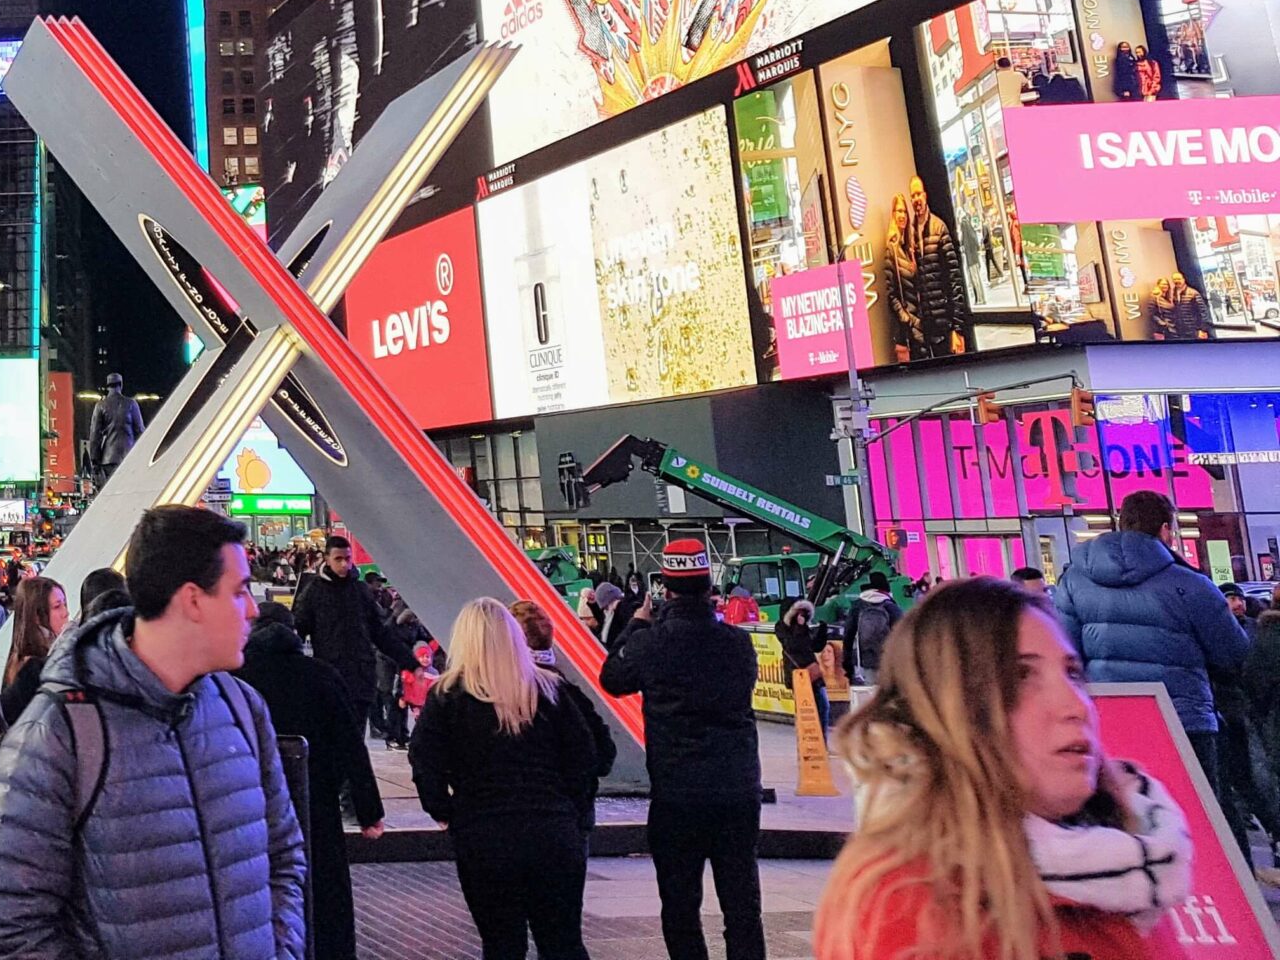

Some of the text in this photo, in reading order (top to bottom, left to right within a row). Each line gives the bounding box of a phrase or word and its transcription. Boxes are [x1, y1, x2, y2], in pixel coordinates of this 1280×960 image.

[500, 0, 544, 40] adidas
[756, 40, 804, 69] MARRIOTT
[757, 56, 801, 83] MARQUIS
[1095, 53, 1110, 79] WE
[1081, 131, 1093, 169] I
[1099, 129, 1207, 168] SAVE
[488, 164, 516, 182] MARRIOTT
[489, 176, 514, 192] MARQUIS
[831, 80, 880, 310] WE NYC
[1117, 227, 1140, 321] WE NYC
[179, 272, 203, 304] FIND
[203, 305, 229, 333] LOVE
[787, 308, 855, 340] BLAZING-FAT
[529, 348, 563, 368] CLINIQUE
[47, 381, 60, 486] ANTHEM
[1107, 443, 1189, 481] ONE
[701, 472, 755, 504] SUNBELT
[756, 496, 811, 529] RENTALS
[690, 555, 708, 567] YO
